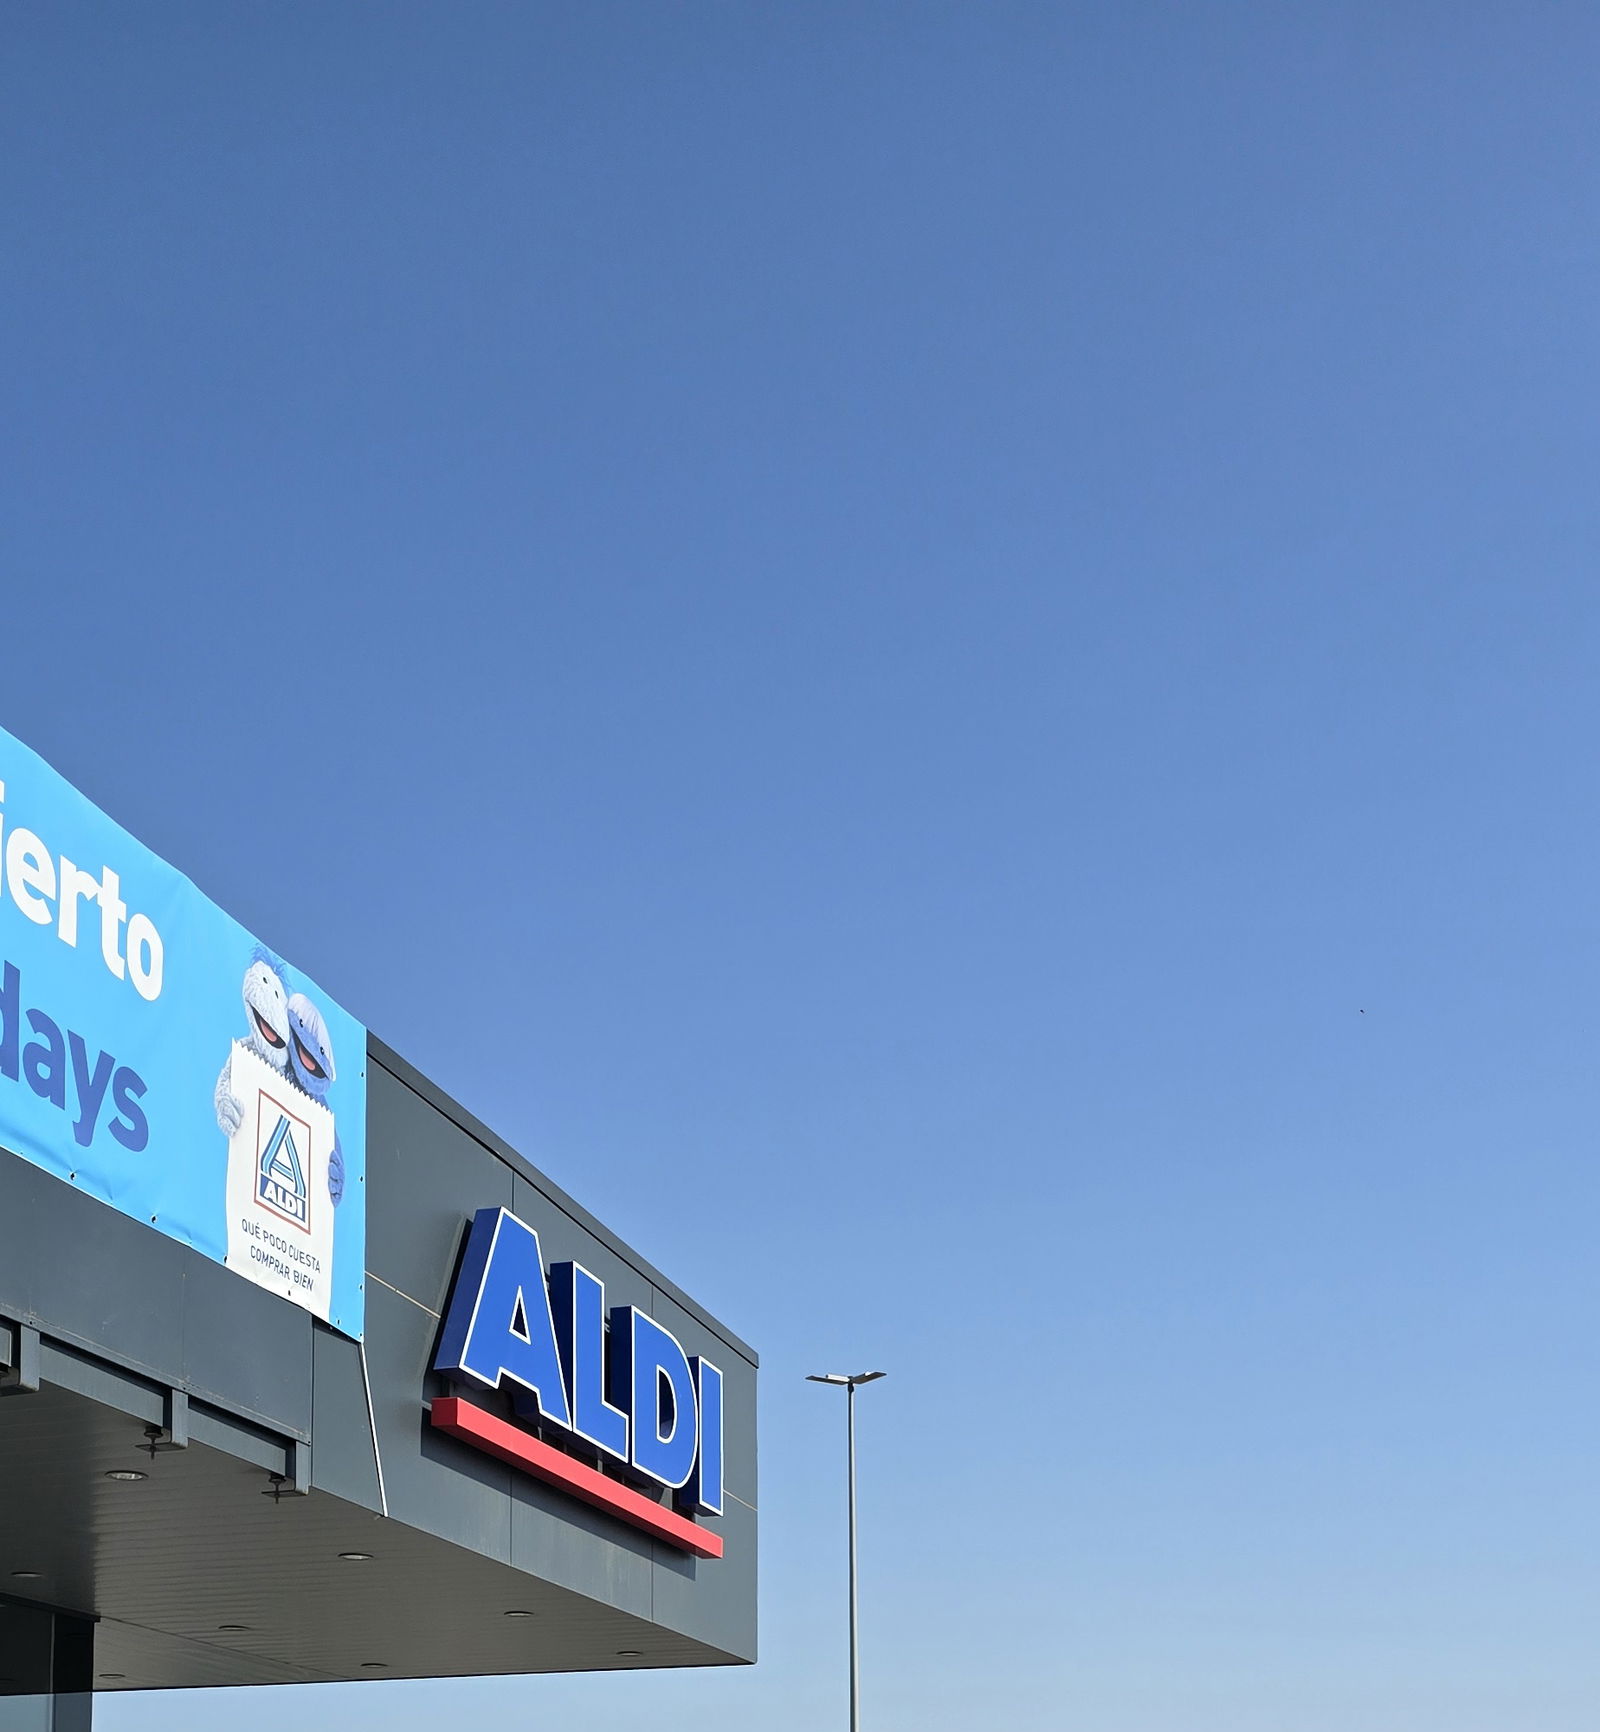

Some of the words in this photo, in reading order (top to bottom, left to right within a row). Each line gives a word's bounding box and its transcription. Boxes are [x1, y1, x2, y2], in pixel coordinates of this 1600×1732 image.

[0, 780, 163, 1001] erto
[263, 1181, 304, 1220] ALDI
[241, 1219, 261, 1241] QUÉ
[263, 1230, 287, 1254] POCO
[288, 1243, 321, 1274] CUESTA
[250, 1245, 291, 1280] COMPRAR
[293, 1270, 314, 1292] BIEN
[436, 1205, 724, 1517] ALDI
